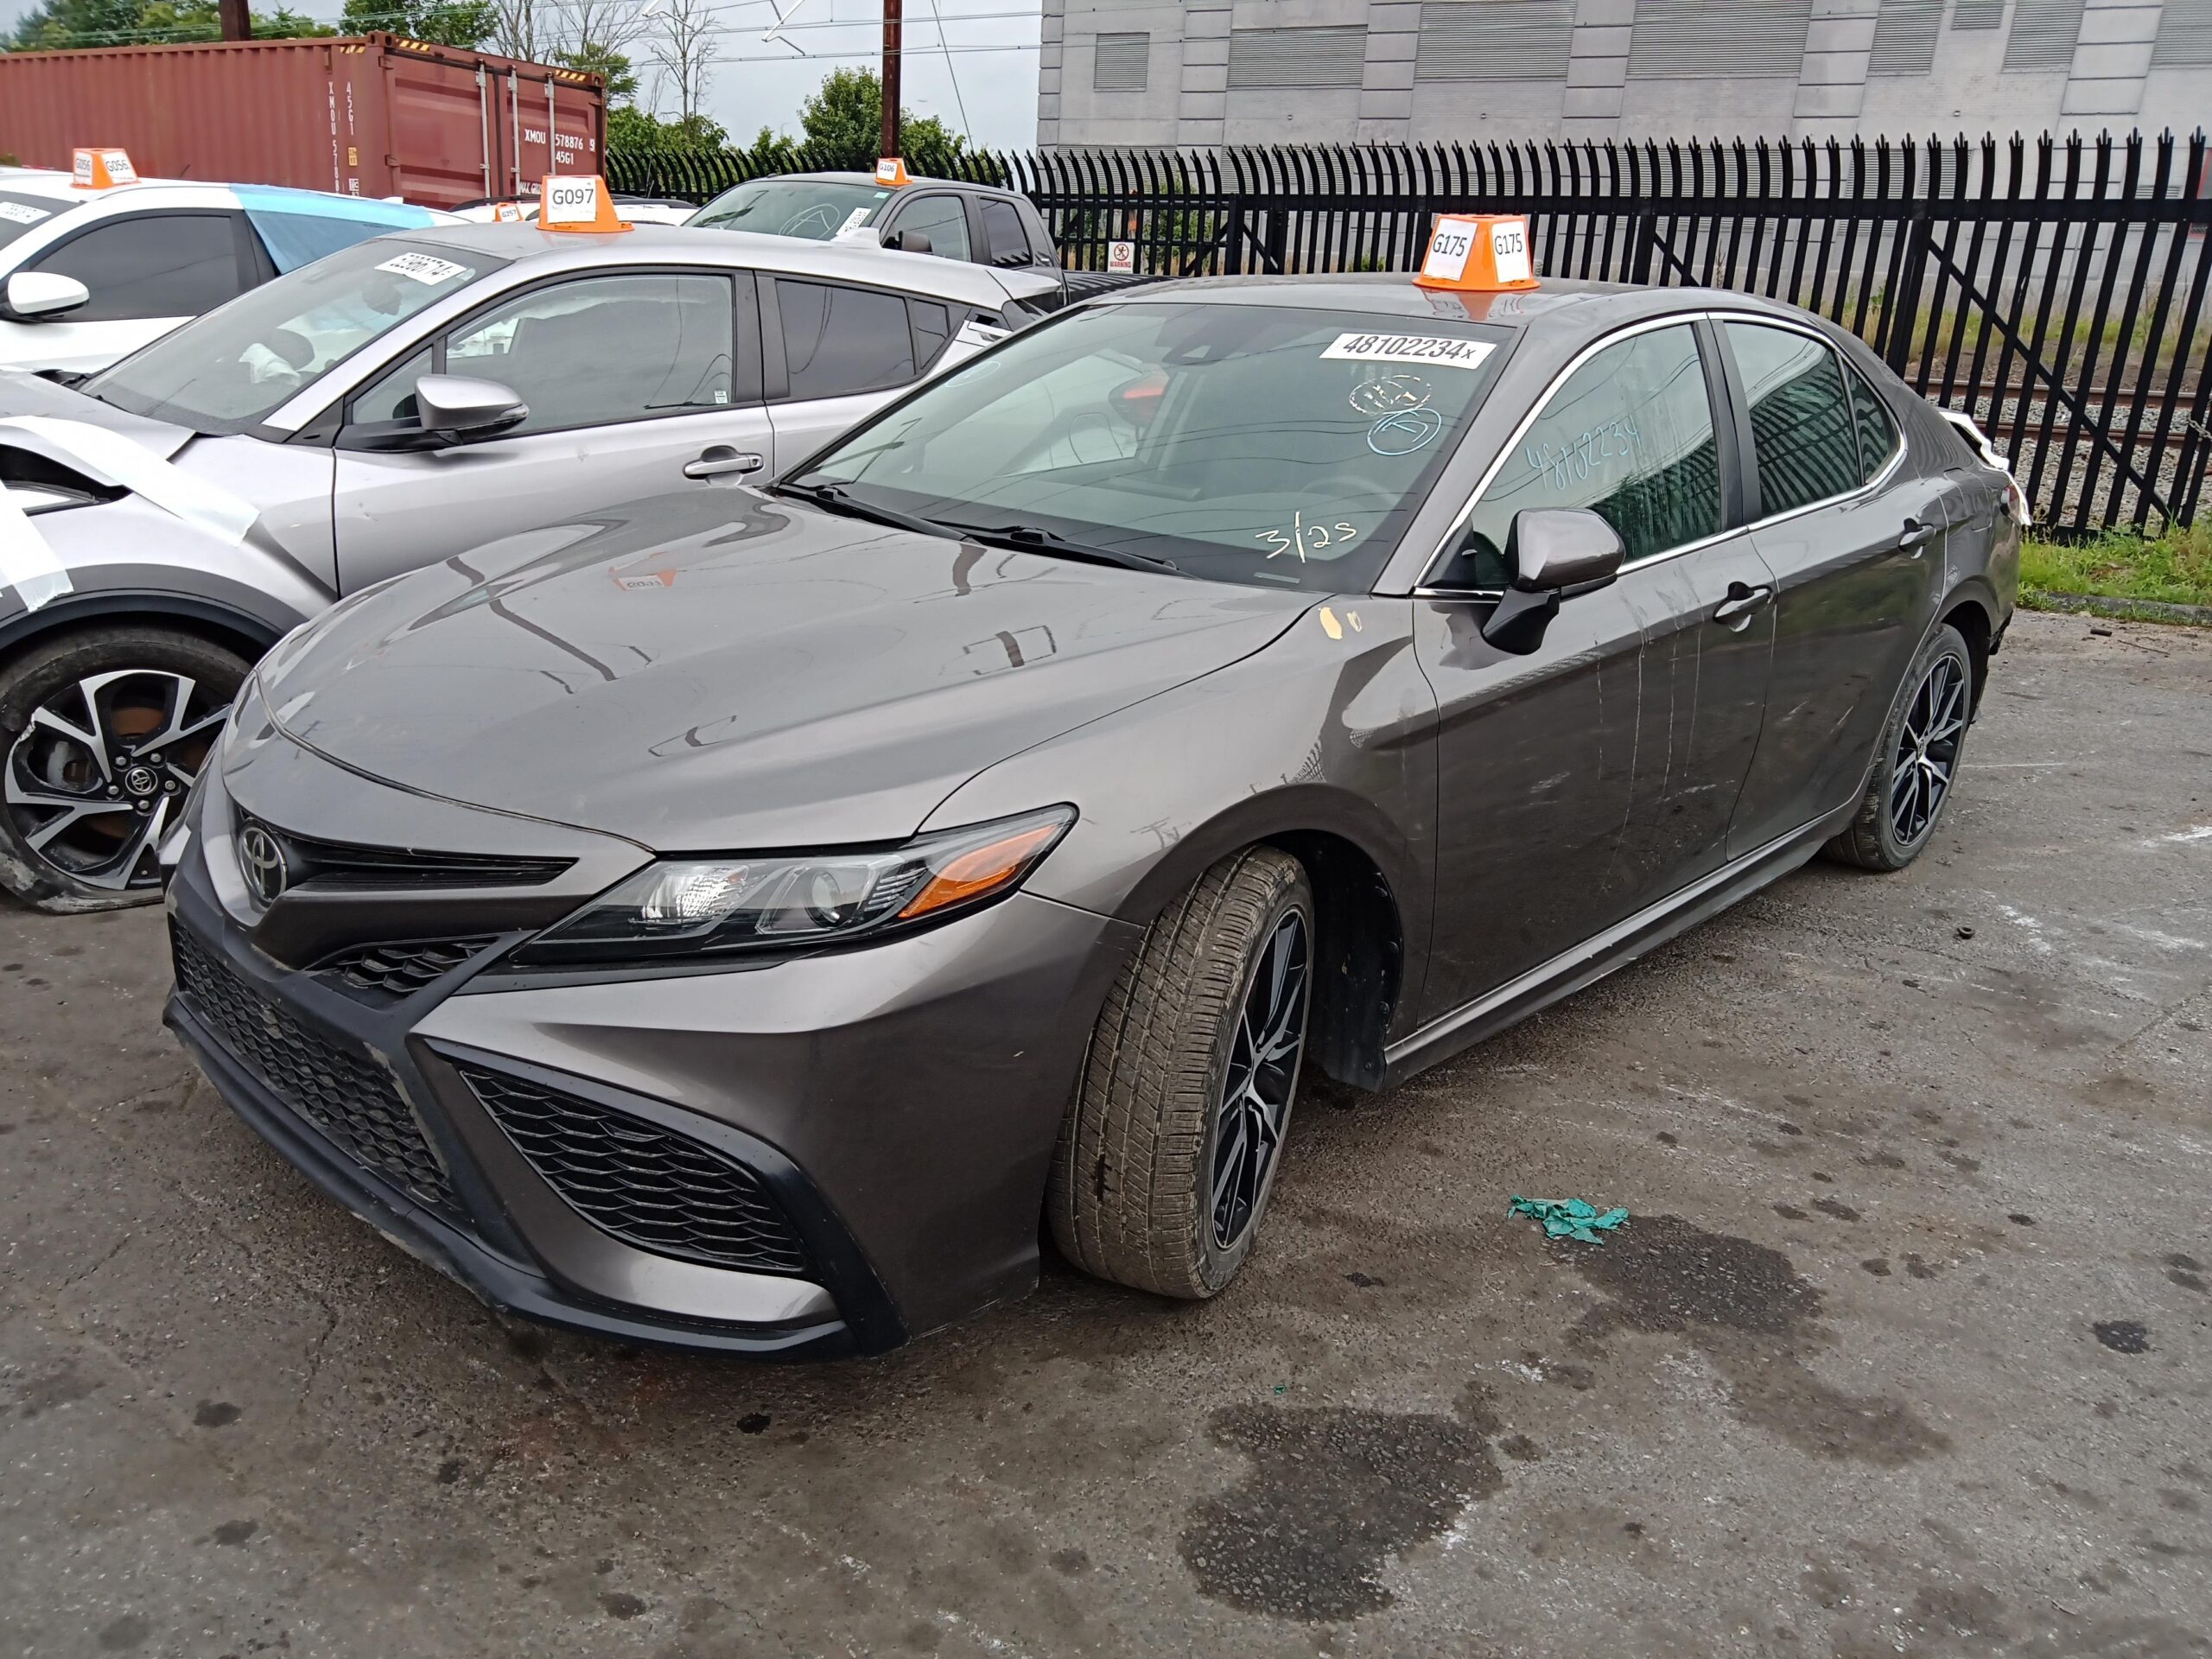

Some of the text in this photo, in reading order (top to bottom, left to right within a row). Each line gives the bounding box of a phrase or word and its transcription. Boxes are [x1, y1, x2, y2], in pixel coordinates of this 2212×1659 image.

[328, 81, 337, 136] XMOU
[524, 129, 596, 153] XMOU 578876 9
[105, 160, 130, 172] G056
[556, 150, 574, 165] 45G1
[879, 162, 895, 173] G106
[552, 188, 594, 205] G097
[502, 209, 517, 218] G257
[1433, 233, 1467, 257] G175
[1494, 232, 1522, 255] G175
[1525, 414, 1642, 491] 48102234
